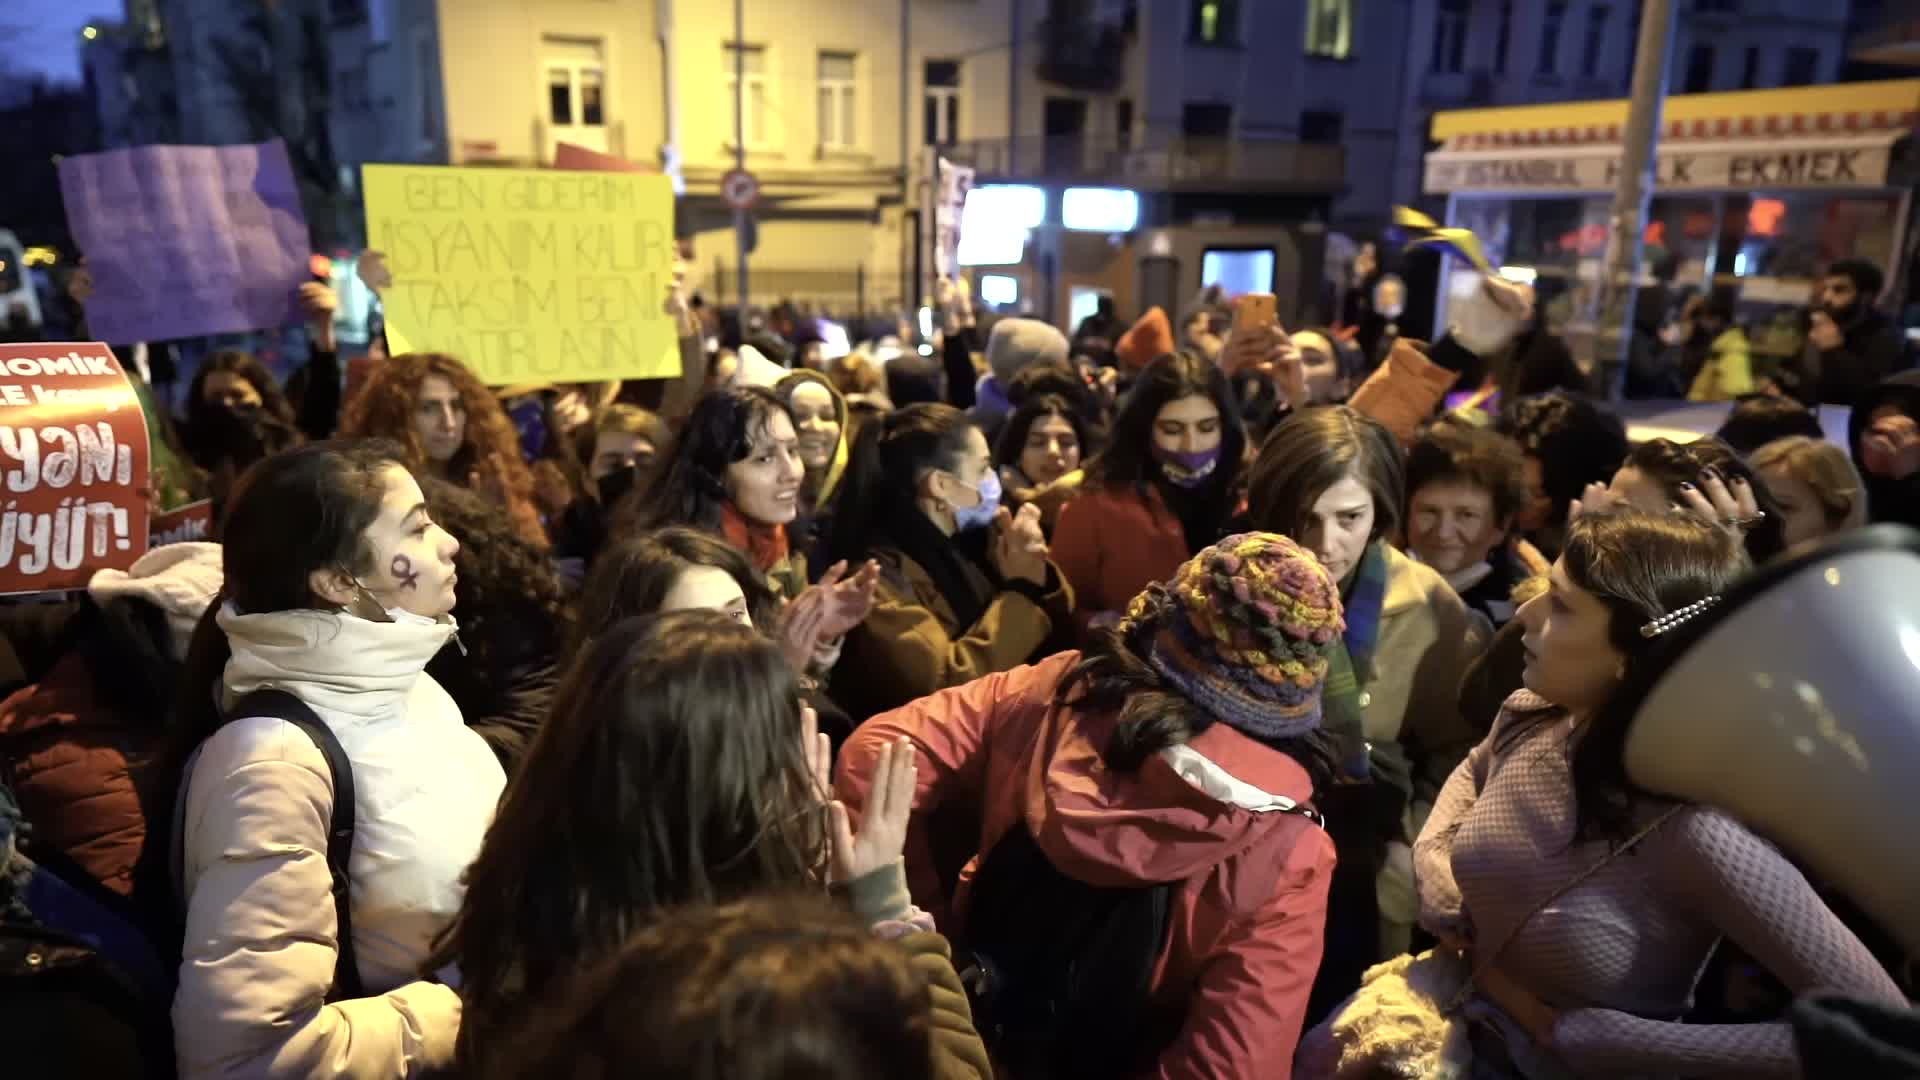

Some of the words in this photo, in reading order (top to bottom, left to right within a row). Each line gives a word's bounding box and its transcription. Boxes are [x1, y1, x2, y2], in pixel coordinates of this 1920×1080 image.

[1605, 155, 1696, 185] HK
[1729, 149, 1861, 184] EKMEK
[404, 174, 485, 212] BEN
[574, 218, 668, 273] KALIR
[0, 385, 31, 406] E
